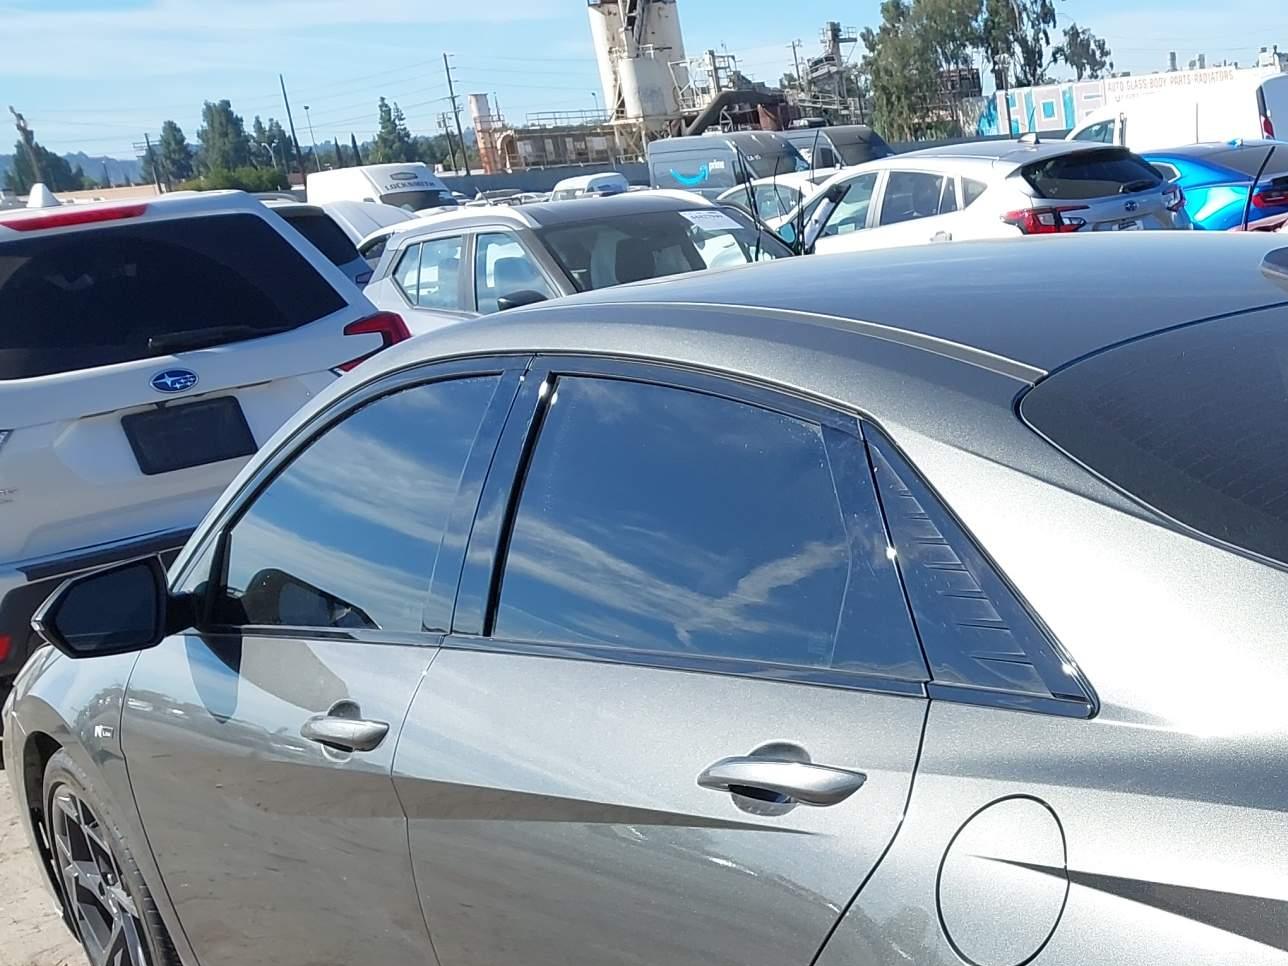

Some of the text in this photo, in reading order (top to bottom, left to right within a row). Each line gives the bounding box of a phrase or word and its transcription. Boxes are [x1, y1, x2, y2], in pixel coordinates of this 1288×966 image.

[1107, 80, 1125, 92] AUTO
[1126, 79, 1147, 91] GLASS
[1150, 78, 1166, 89] BODY
[1194, 70, 1234, 84] RADIATORS
